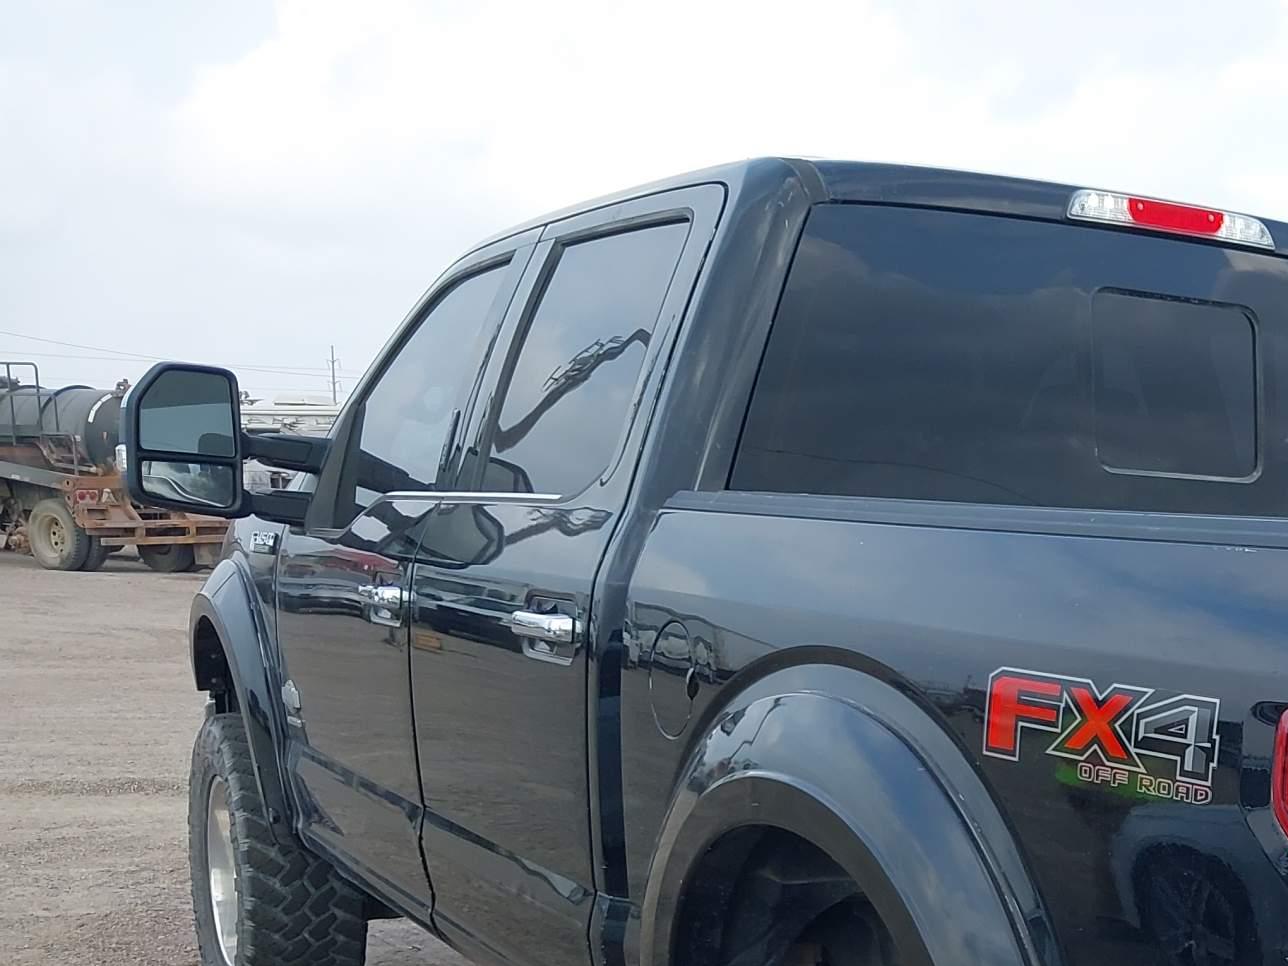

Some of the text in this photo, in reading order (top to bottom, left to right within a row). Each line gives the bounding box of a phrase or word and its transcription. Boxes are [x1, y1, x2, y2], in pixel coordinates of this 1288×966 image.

[983, 666, 1220, 786] FX4
[1077, 763, 1212, 805] OFF ROAD
